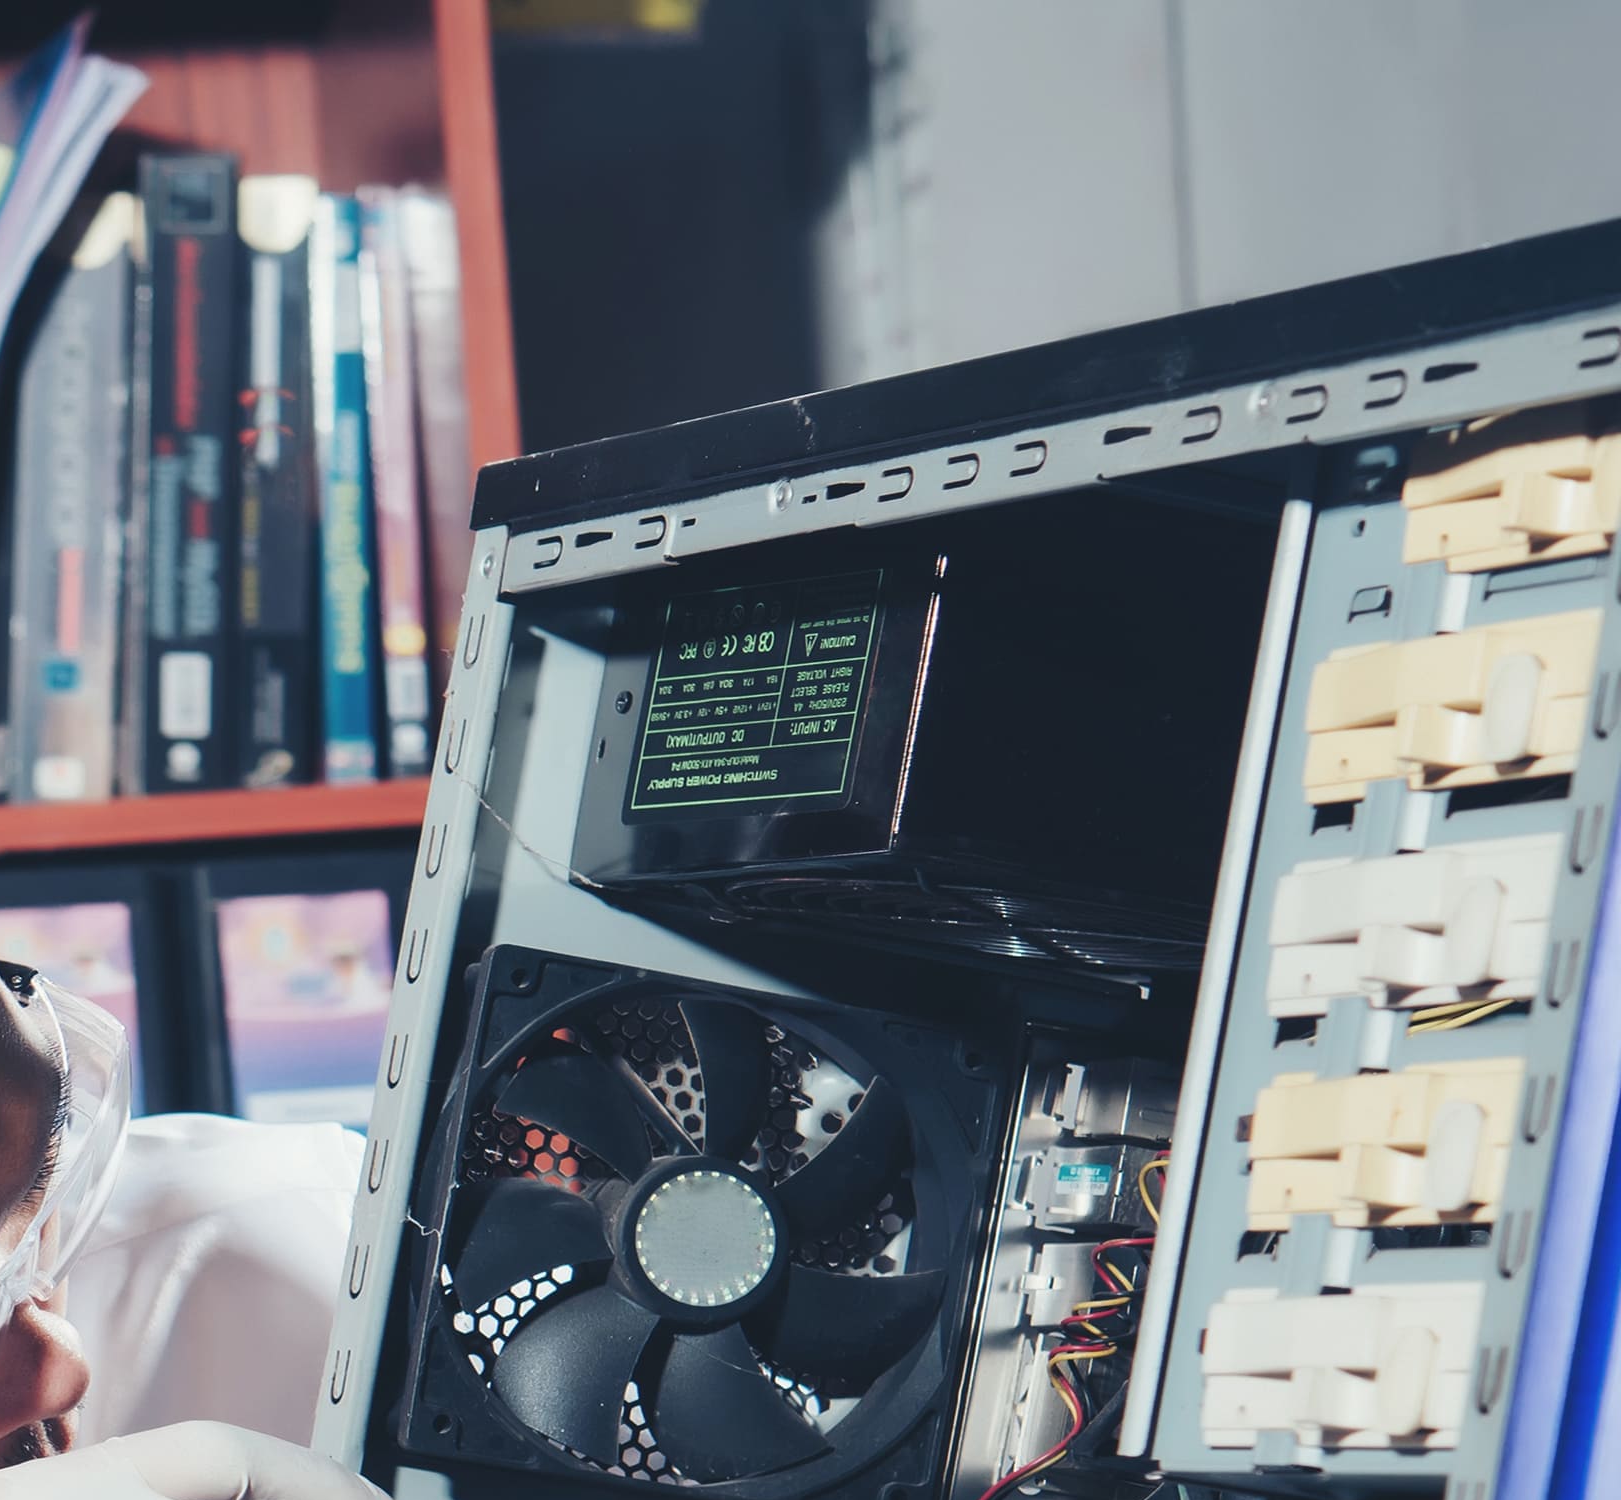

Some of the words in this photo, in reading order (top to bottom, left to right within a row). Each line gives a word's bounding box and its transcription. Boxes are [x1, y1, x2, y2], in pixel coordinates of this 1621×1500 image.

[721, 636, 736, 656] CE
[819, 635, 856, 649] CAUTION!
[797, 669, 827, 681] VOLTAGE
[830, 666, 853, 678] RIGHT
[790, 685, 818, 697] SELECT
[822, 682, 850, 694] PLEASE
[790, 720, 821, 735] INPUT:
[666, 732, 726, 748] OUTPUT(MAX)
[687, 773, 721, 786] POWER
[724, 769, 778, 783] SWITCHING
[647, 777, 684, 790] SUPPLY
